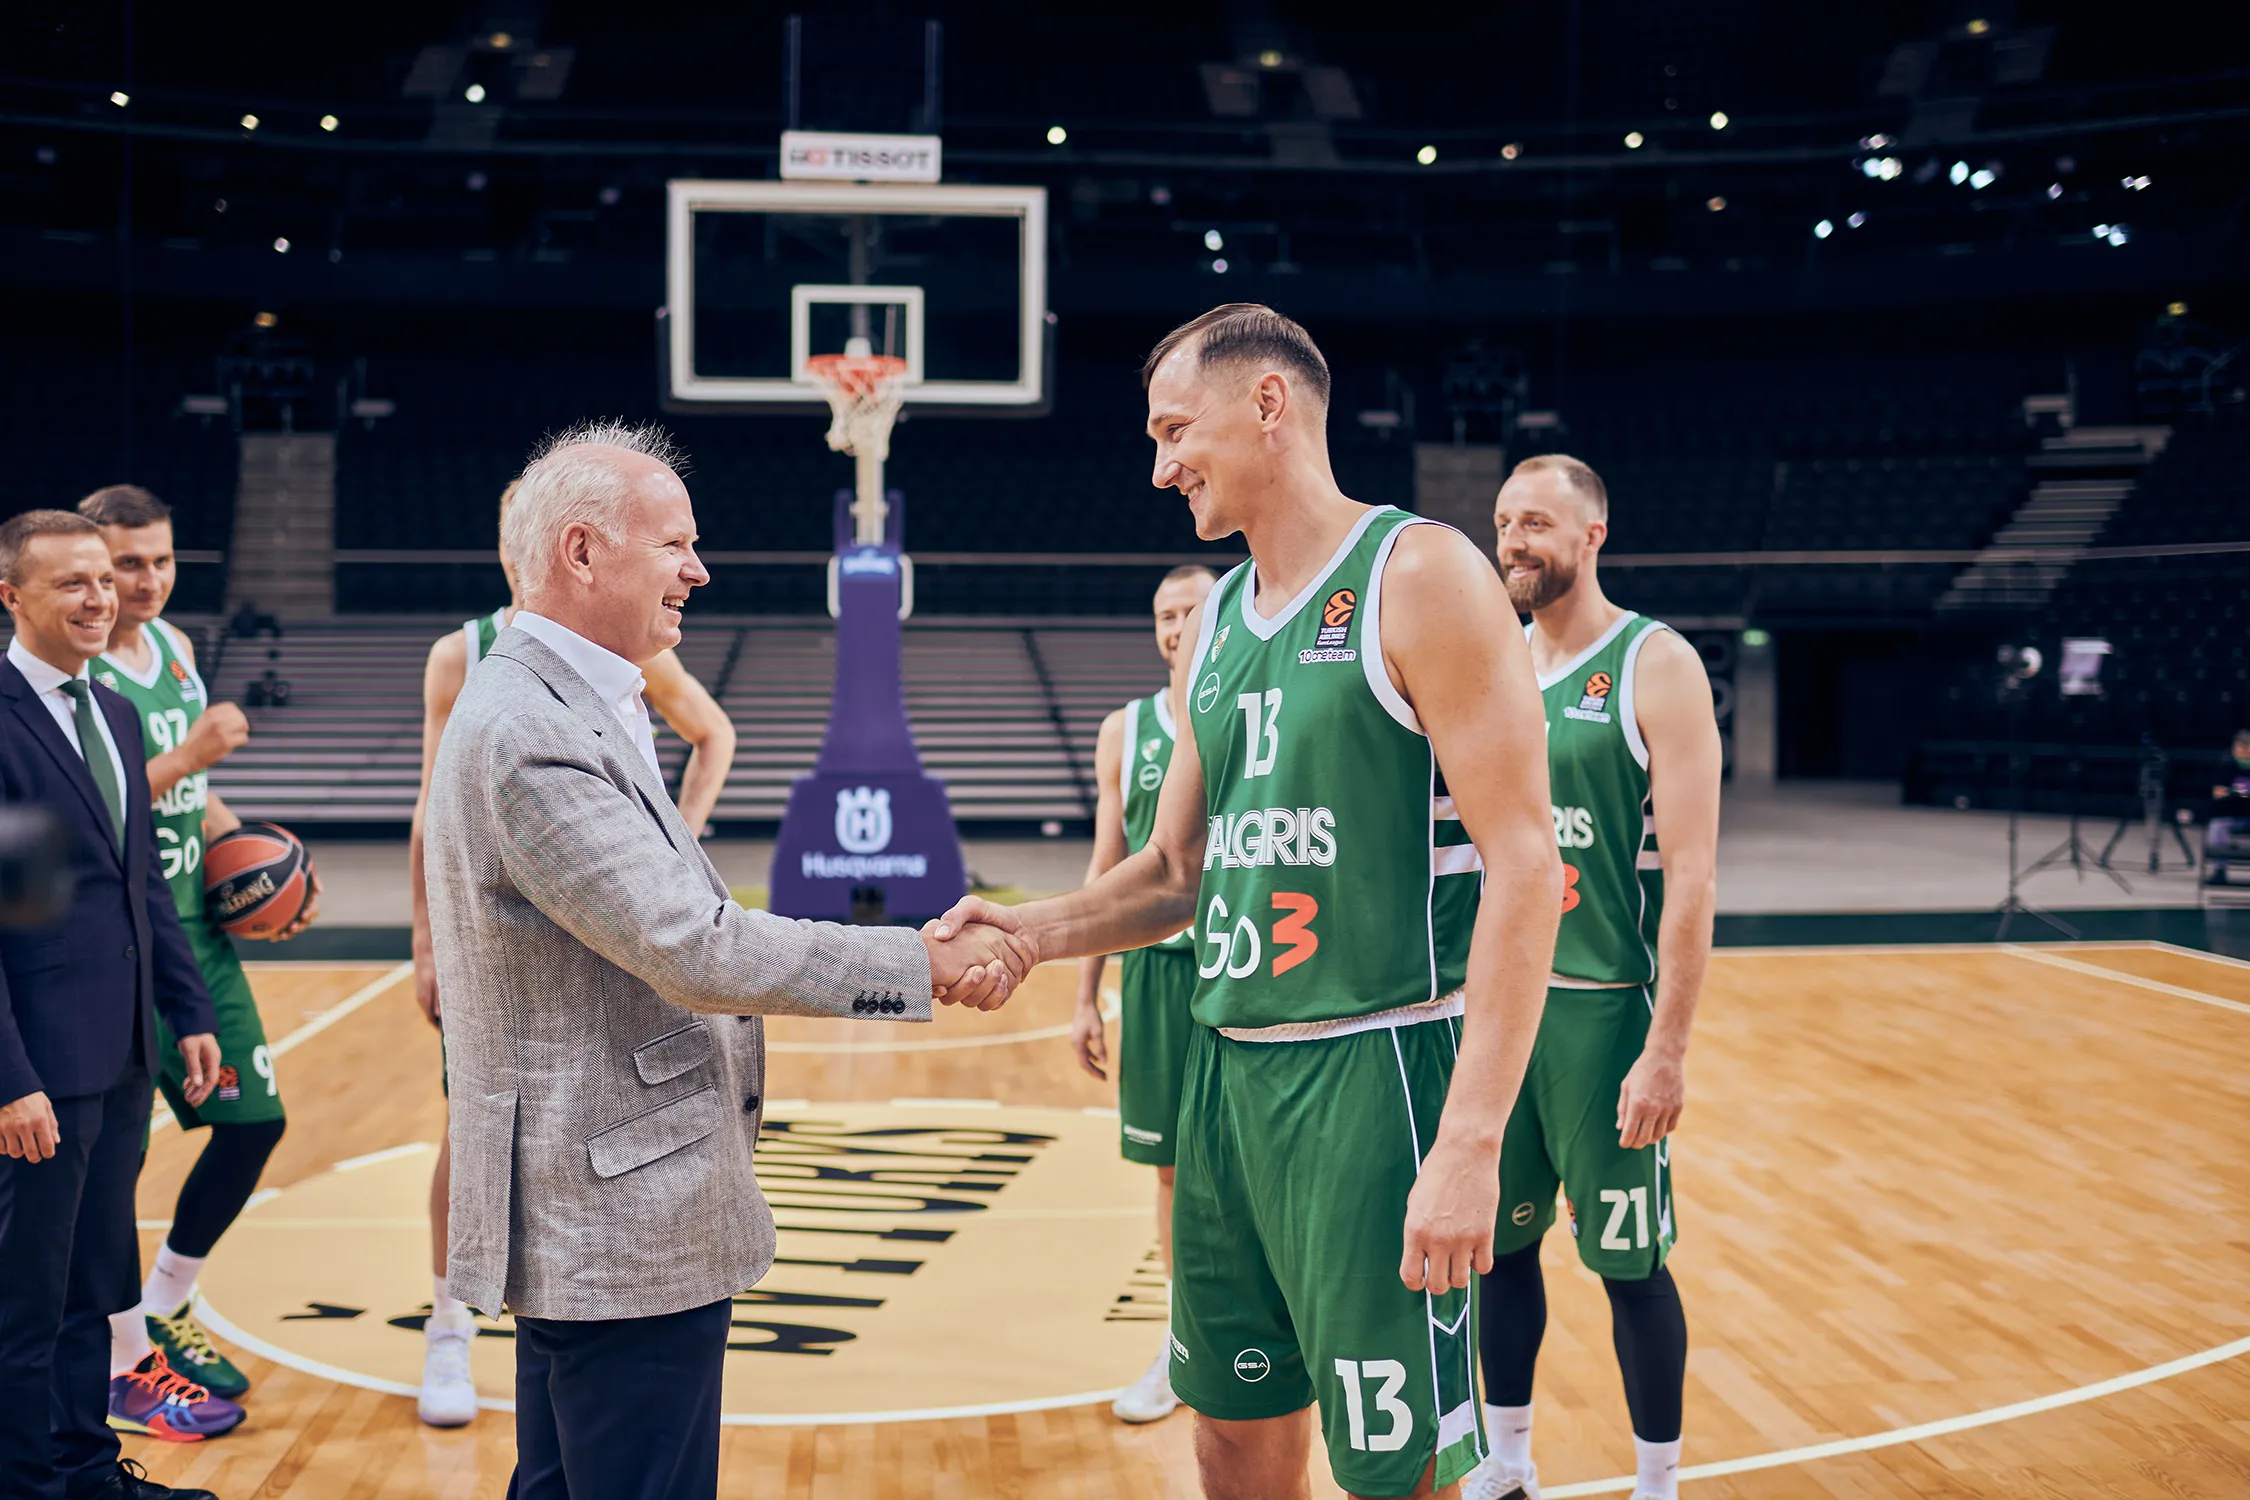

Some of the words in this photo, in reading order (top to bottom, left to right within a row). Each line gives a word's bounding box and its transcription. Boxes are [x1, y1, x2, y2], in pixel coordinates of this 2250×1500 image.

[833, 148, 929, 170] TISSOT
[148, 708, 188, 756] 97
[1237, 687, 1283, 779] 13
[802, 852, 927, 881] Husqvarna
[1600, 1186, 1649, 1250] 21
[1237, 1361, 1268, 1370] GSA
[1334, 1358, 1413, 1452] 13
